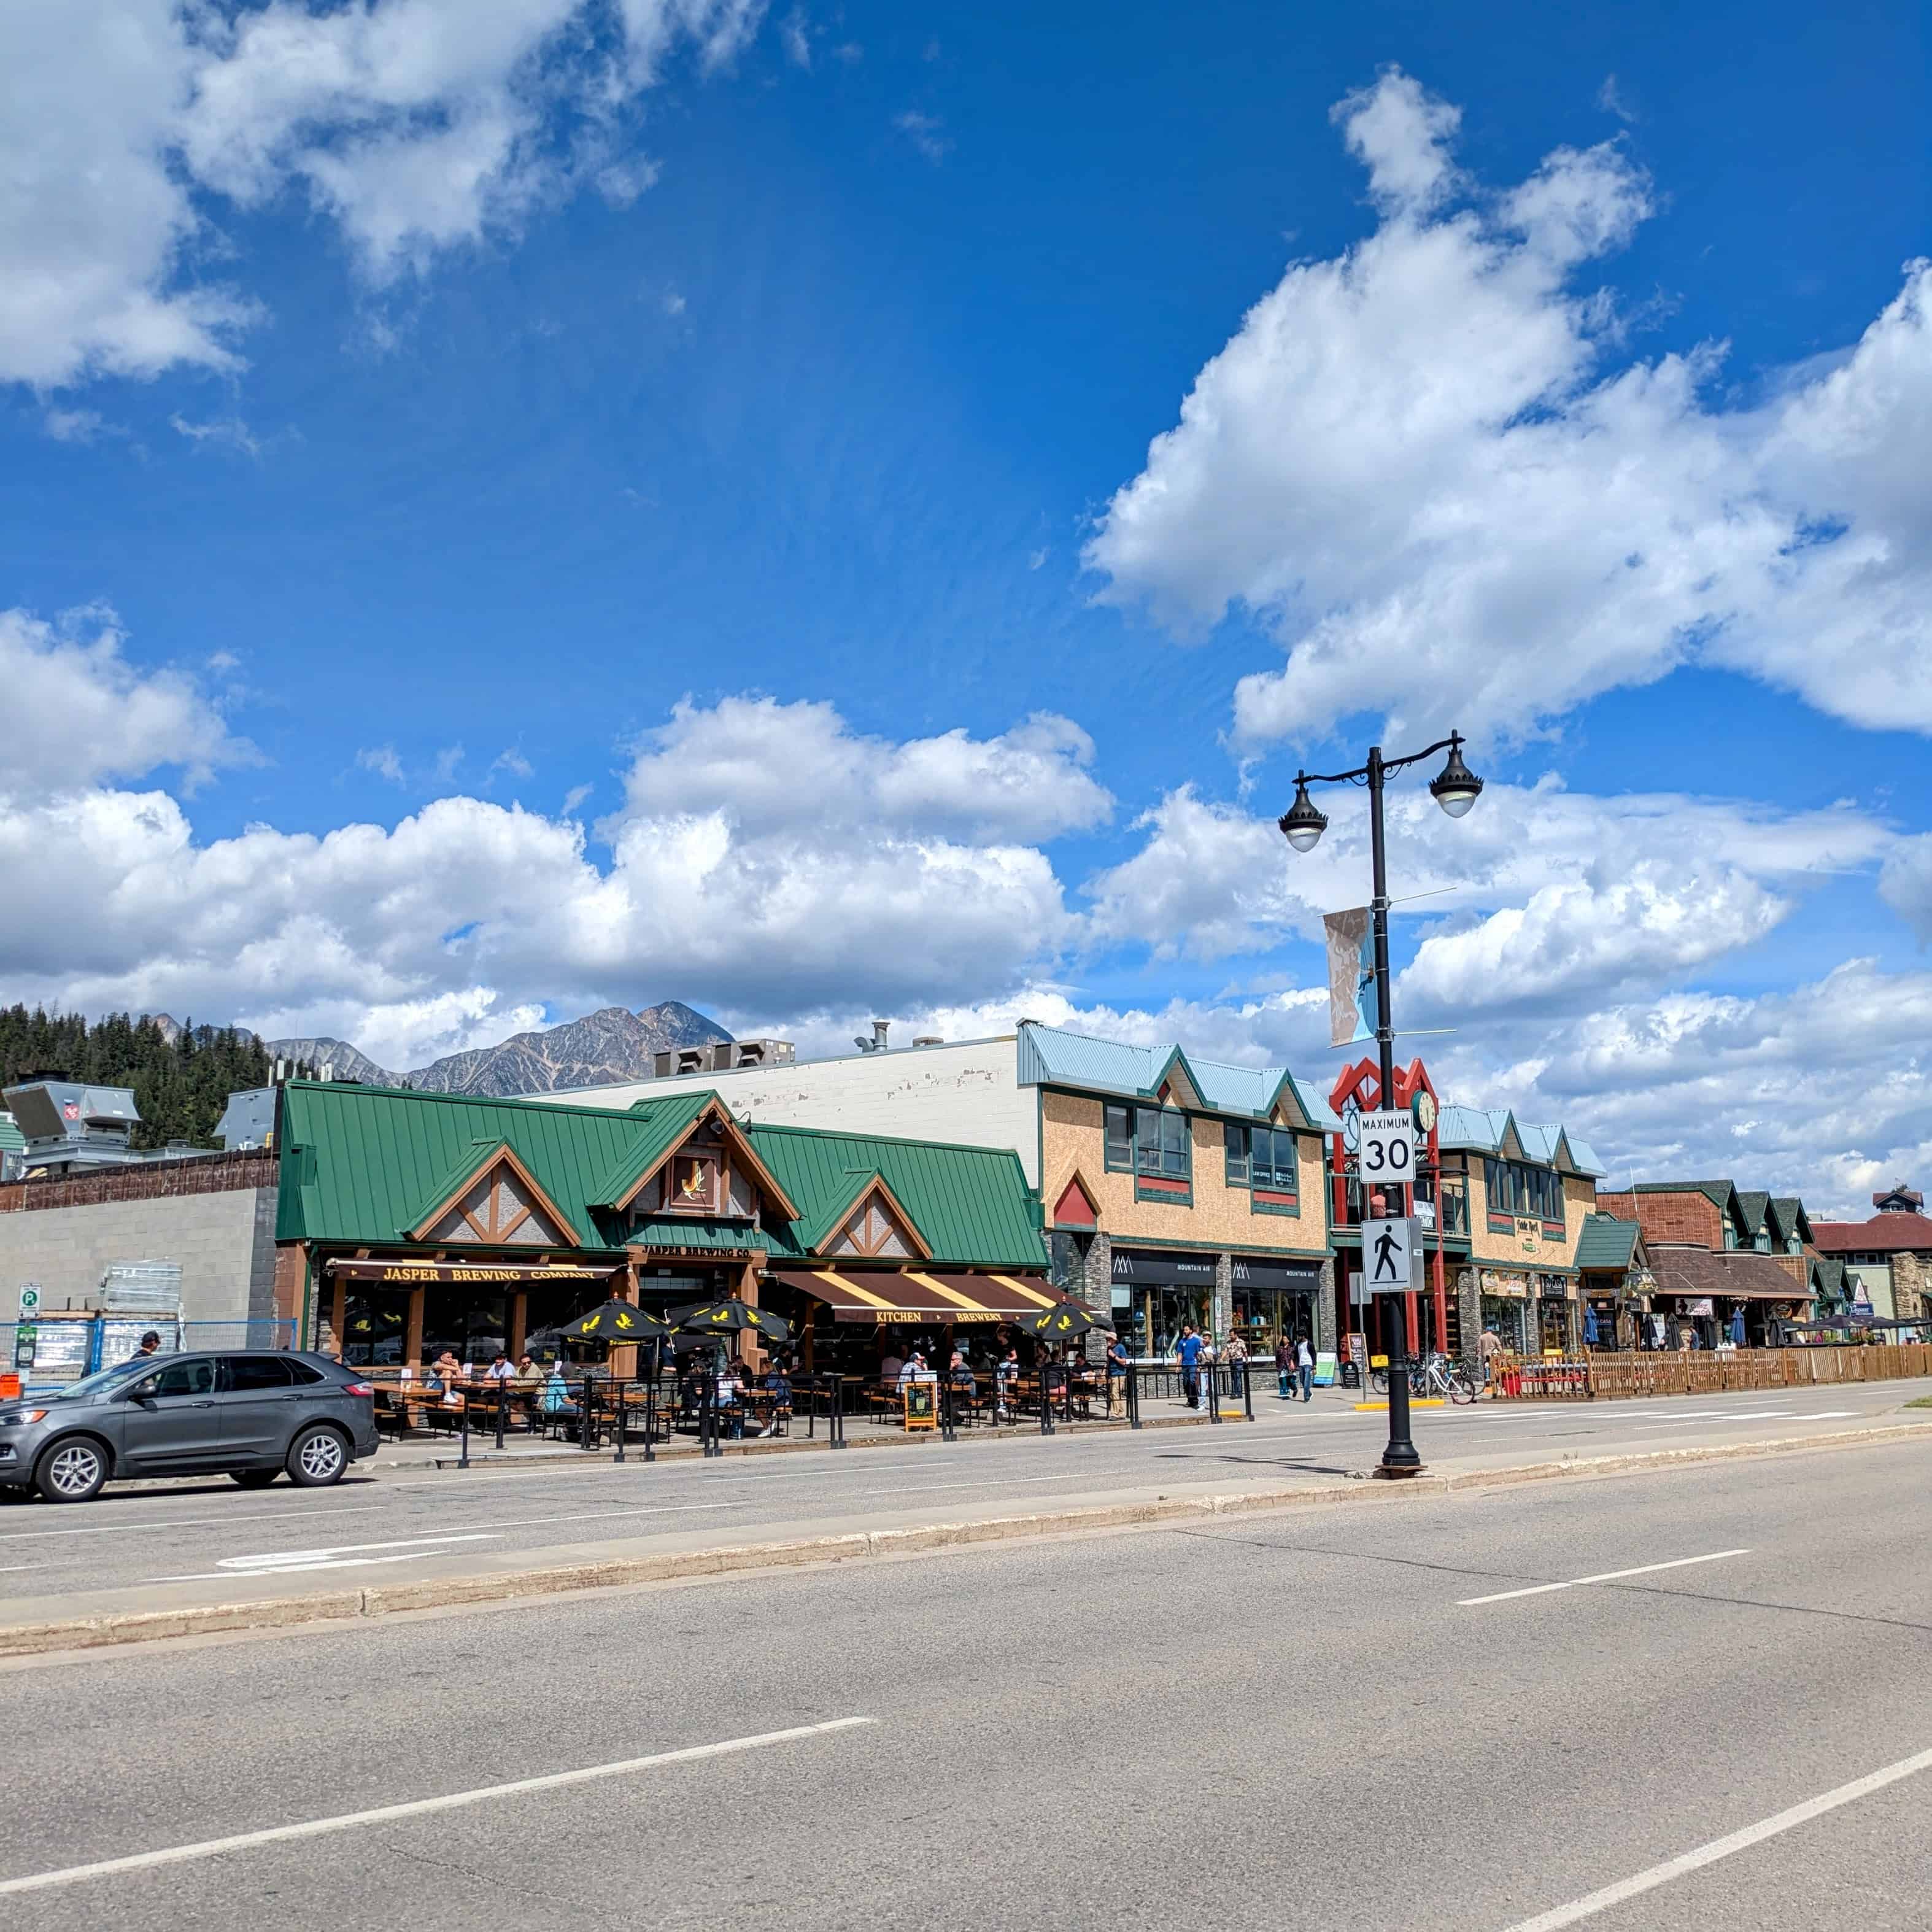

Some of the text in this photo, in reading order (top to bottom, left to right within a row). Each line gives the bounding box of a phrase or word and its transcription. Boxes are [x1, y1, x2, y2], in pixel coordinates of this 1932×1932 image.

[1362, 1118, 1409, 1130] MAXIMUM
[1366, 1138, 1408, 1170] 30
[642, 1245, 752, 1258] JASPER BREWING CO.
[384, 1268, 595, 1281] JASPER BREWING COMPANY
[1551, 1279, 1563, 1288] CASA
[876, 1312, 1002, 1322] KITCHEN BREWERY
